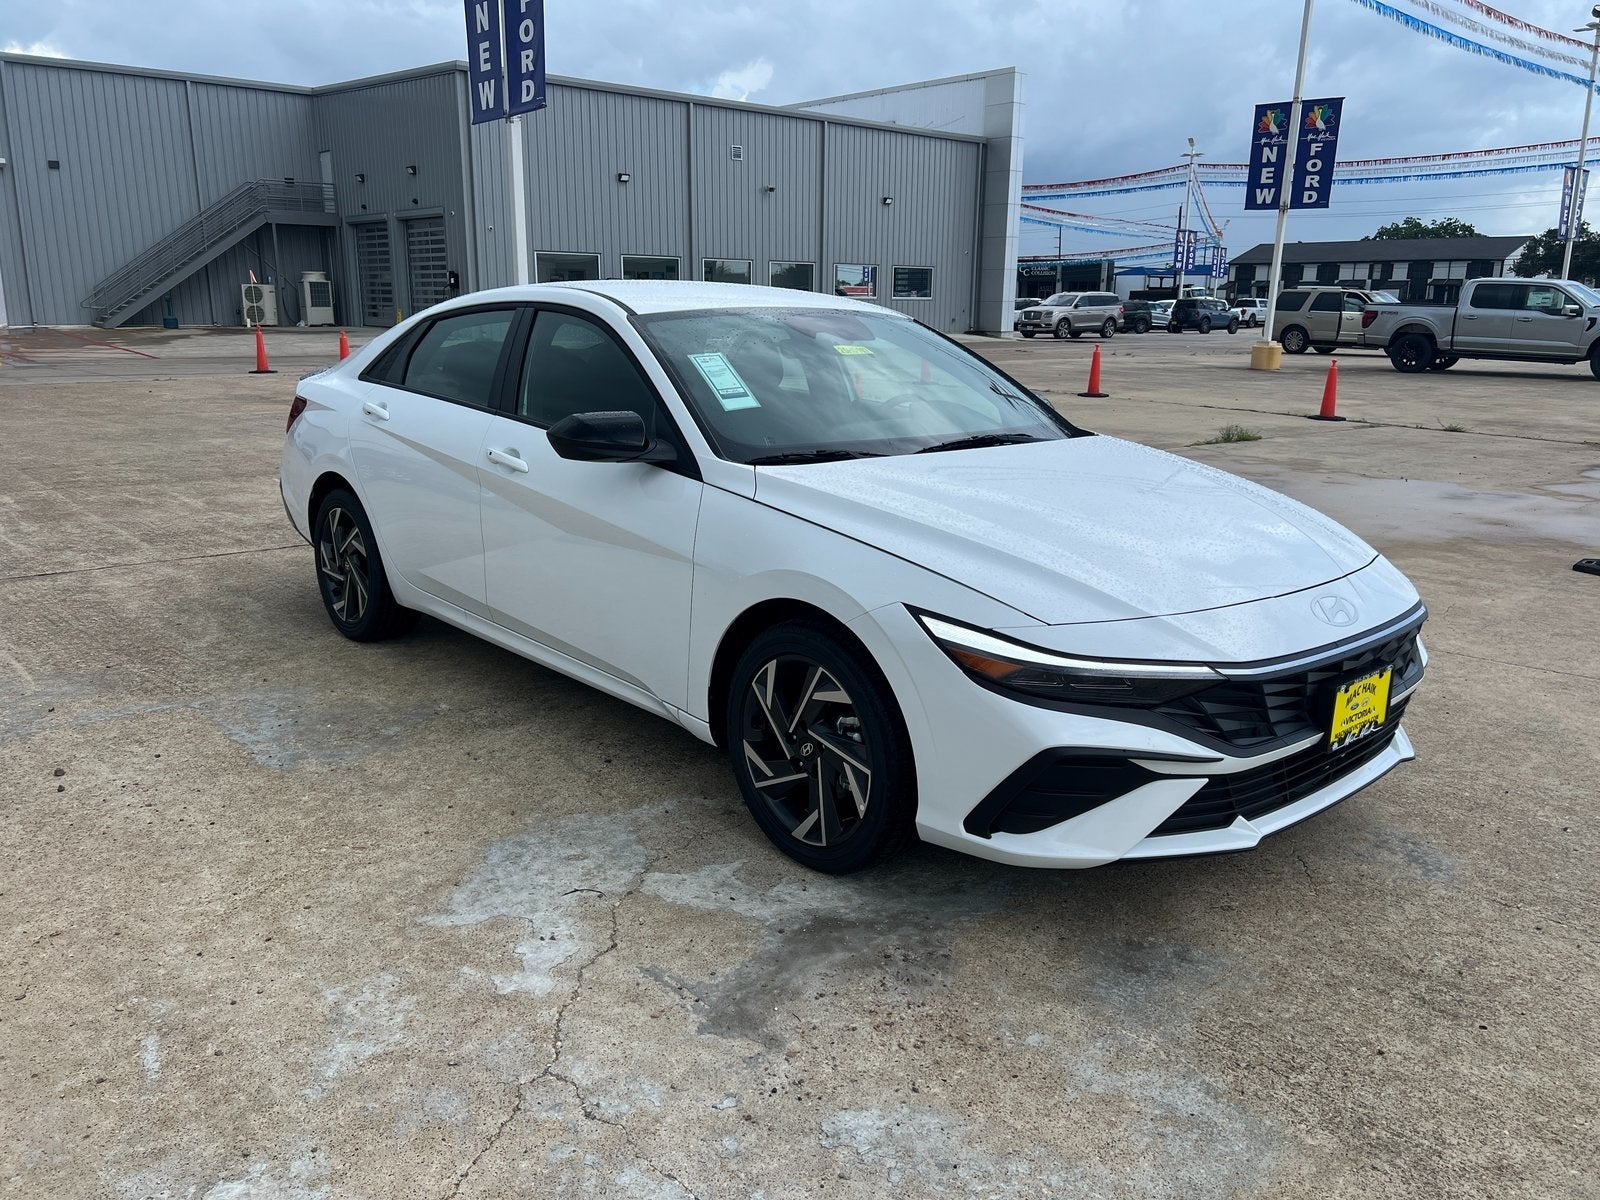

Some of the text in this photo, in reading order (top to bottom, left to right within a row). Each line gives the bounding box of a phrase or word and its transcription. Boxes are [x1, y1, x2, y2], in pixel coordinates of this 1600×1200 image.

[475, 1, 495, 110] NEW
[1256, 147, 1277, 204] NEW
[1302, 143, 1323, 203] FORD
[1175, 245, 1184, 269] NEW
